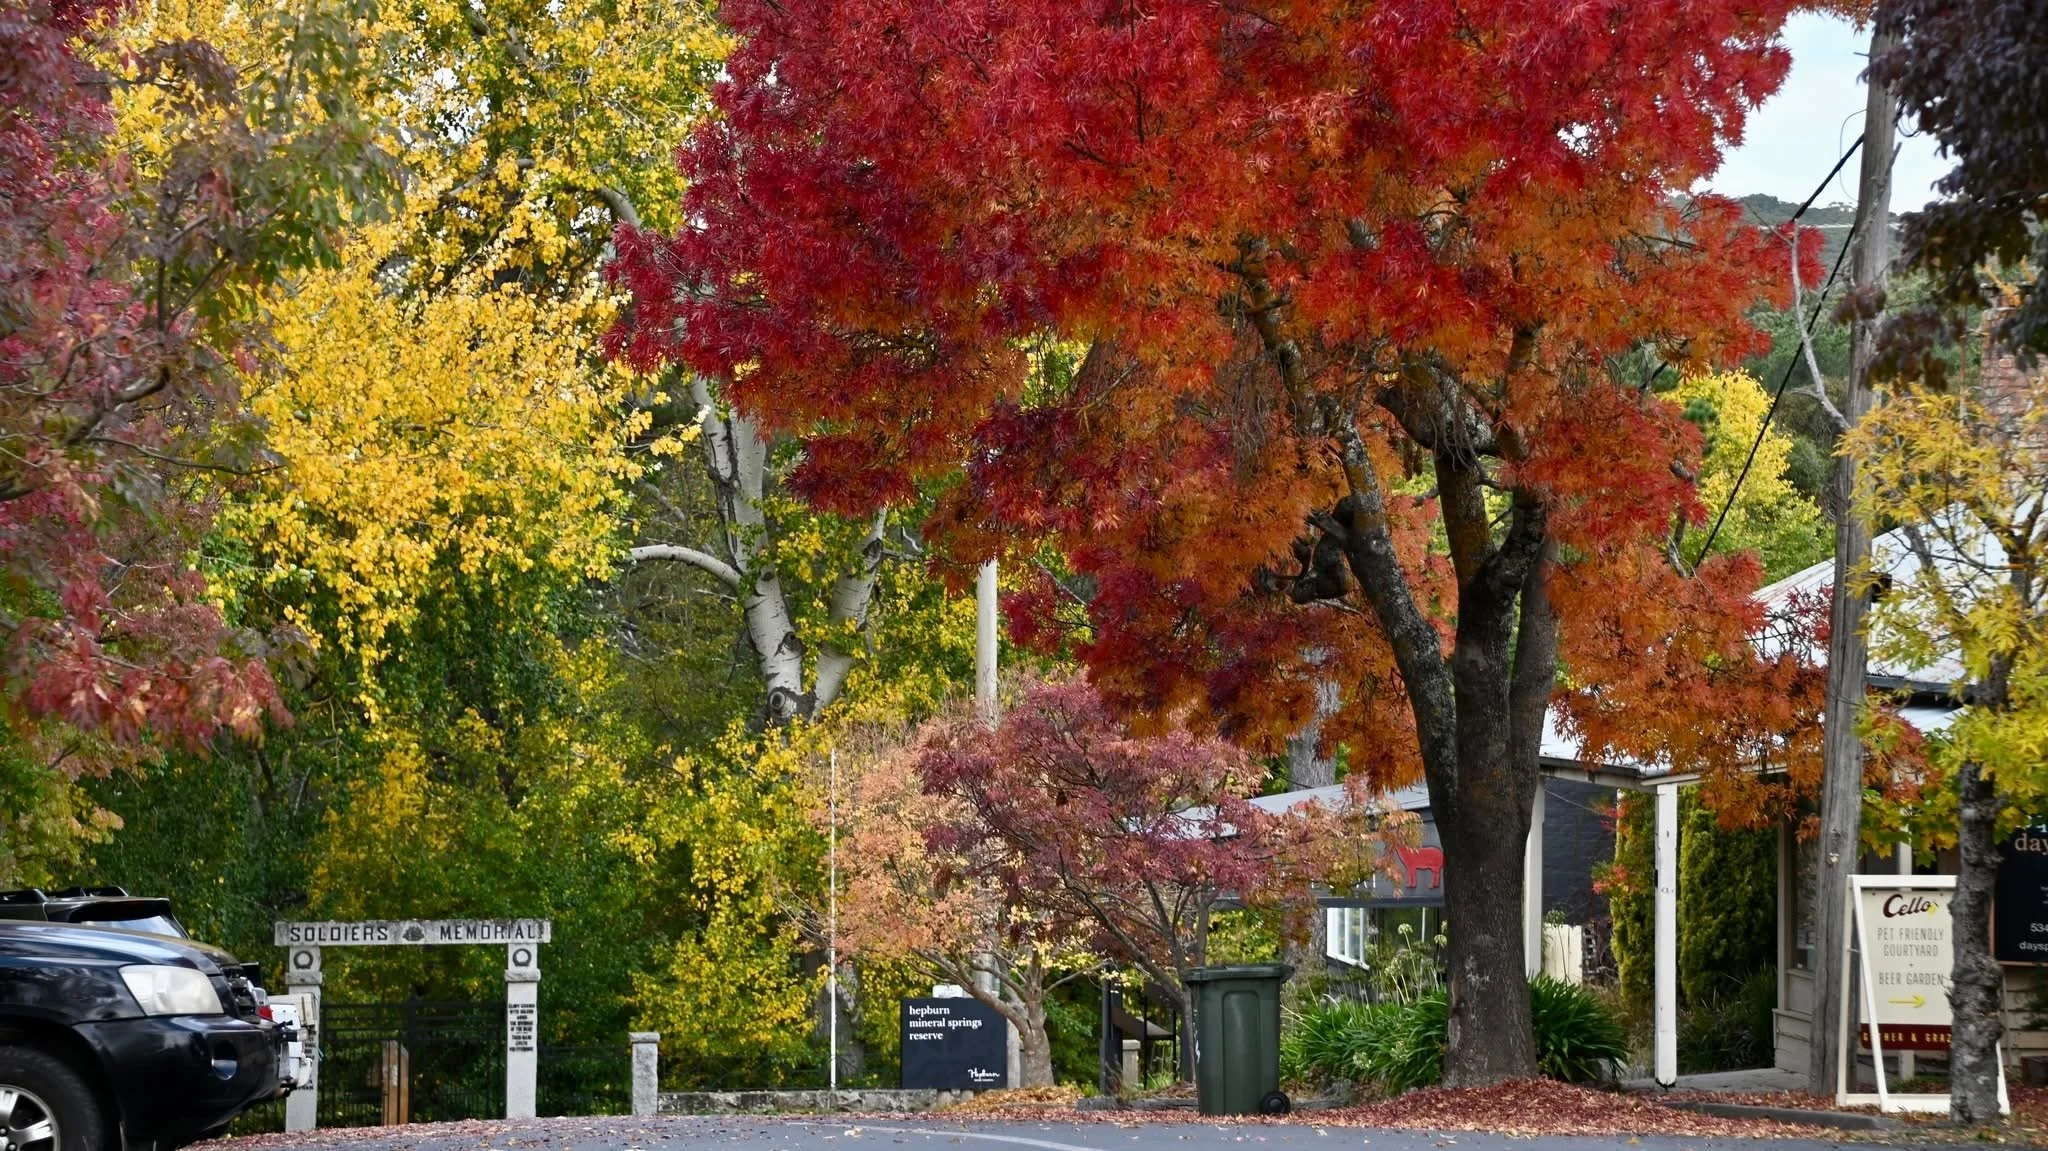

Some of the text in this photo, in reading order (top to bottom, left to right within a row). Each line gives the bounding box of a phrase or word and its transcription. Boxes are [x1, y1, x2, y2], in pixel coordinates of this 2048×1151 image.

[290, 924, 536, 941] SOLDIERS MEMORIAL
[1877, 927, 1944, 941] PET FRIENDLY
[1883, 944, 1939, 957] COURTYARD
[1878, 972, 1943, 985] BEER GARDEN
[909, 1005, 950, 1018] hepburn
[909, 1017, 983, 1030] mineral springs
[909, 1032, 944, 1041] reserve
[1863, 1032, 1904, 1042] GHER
